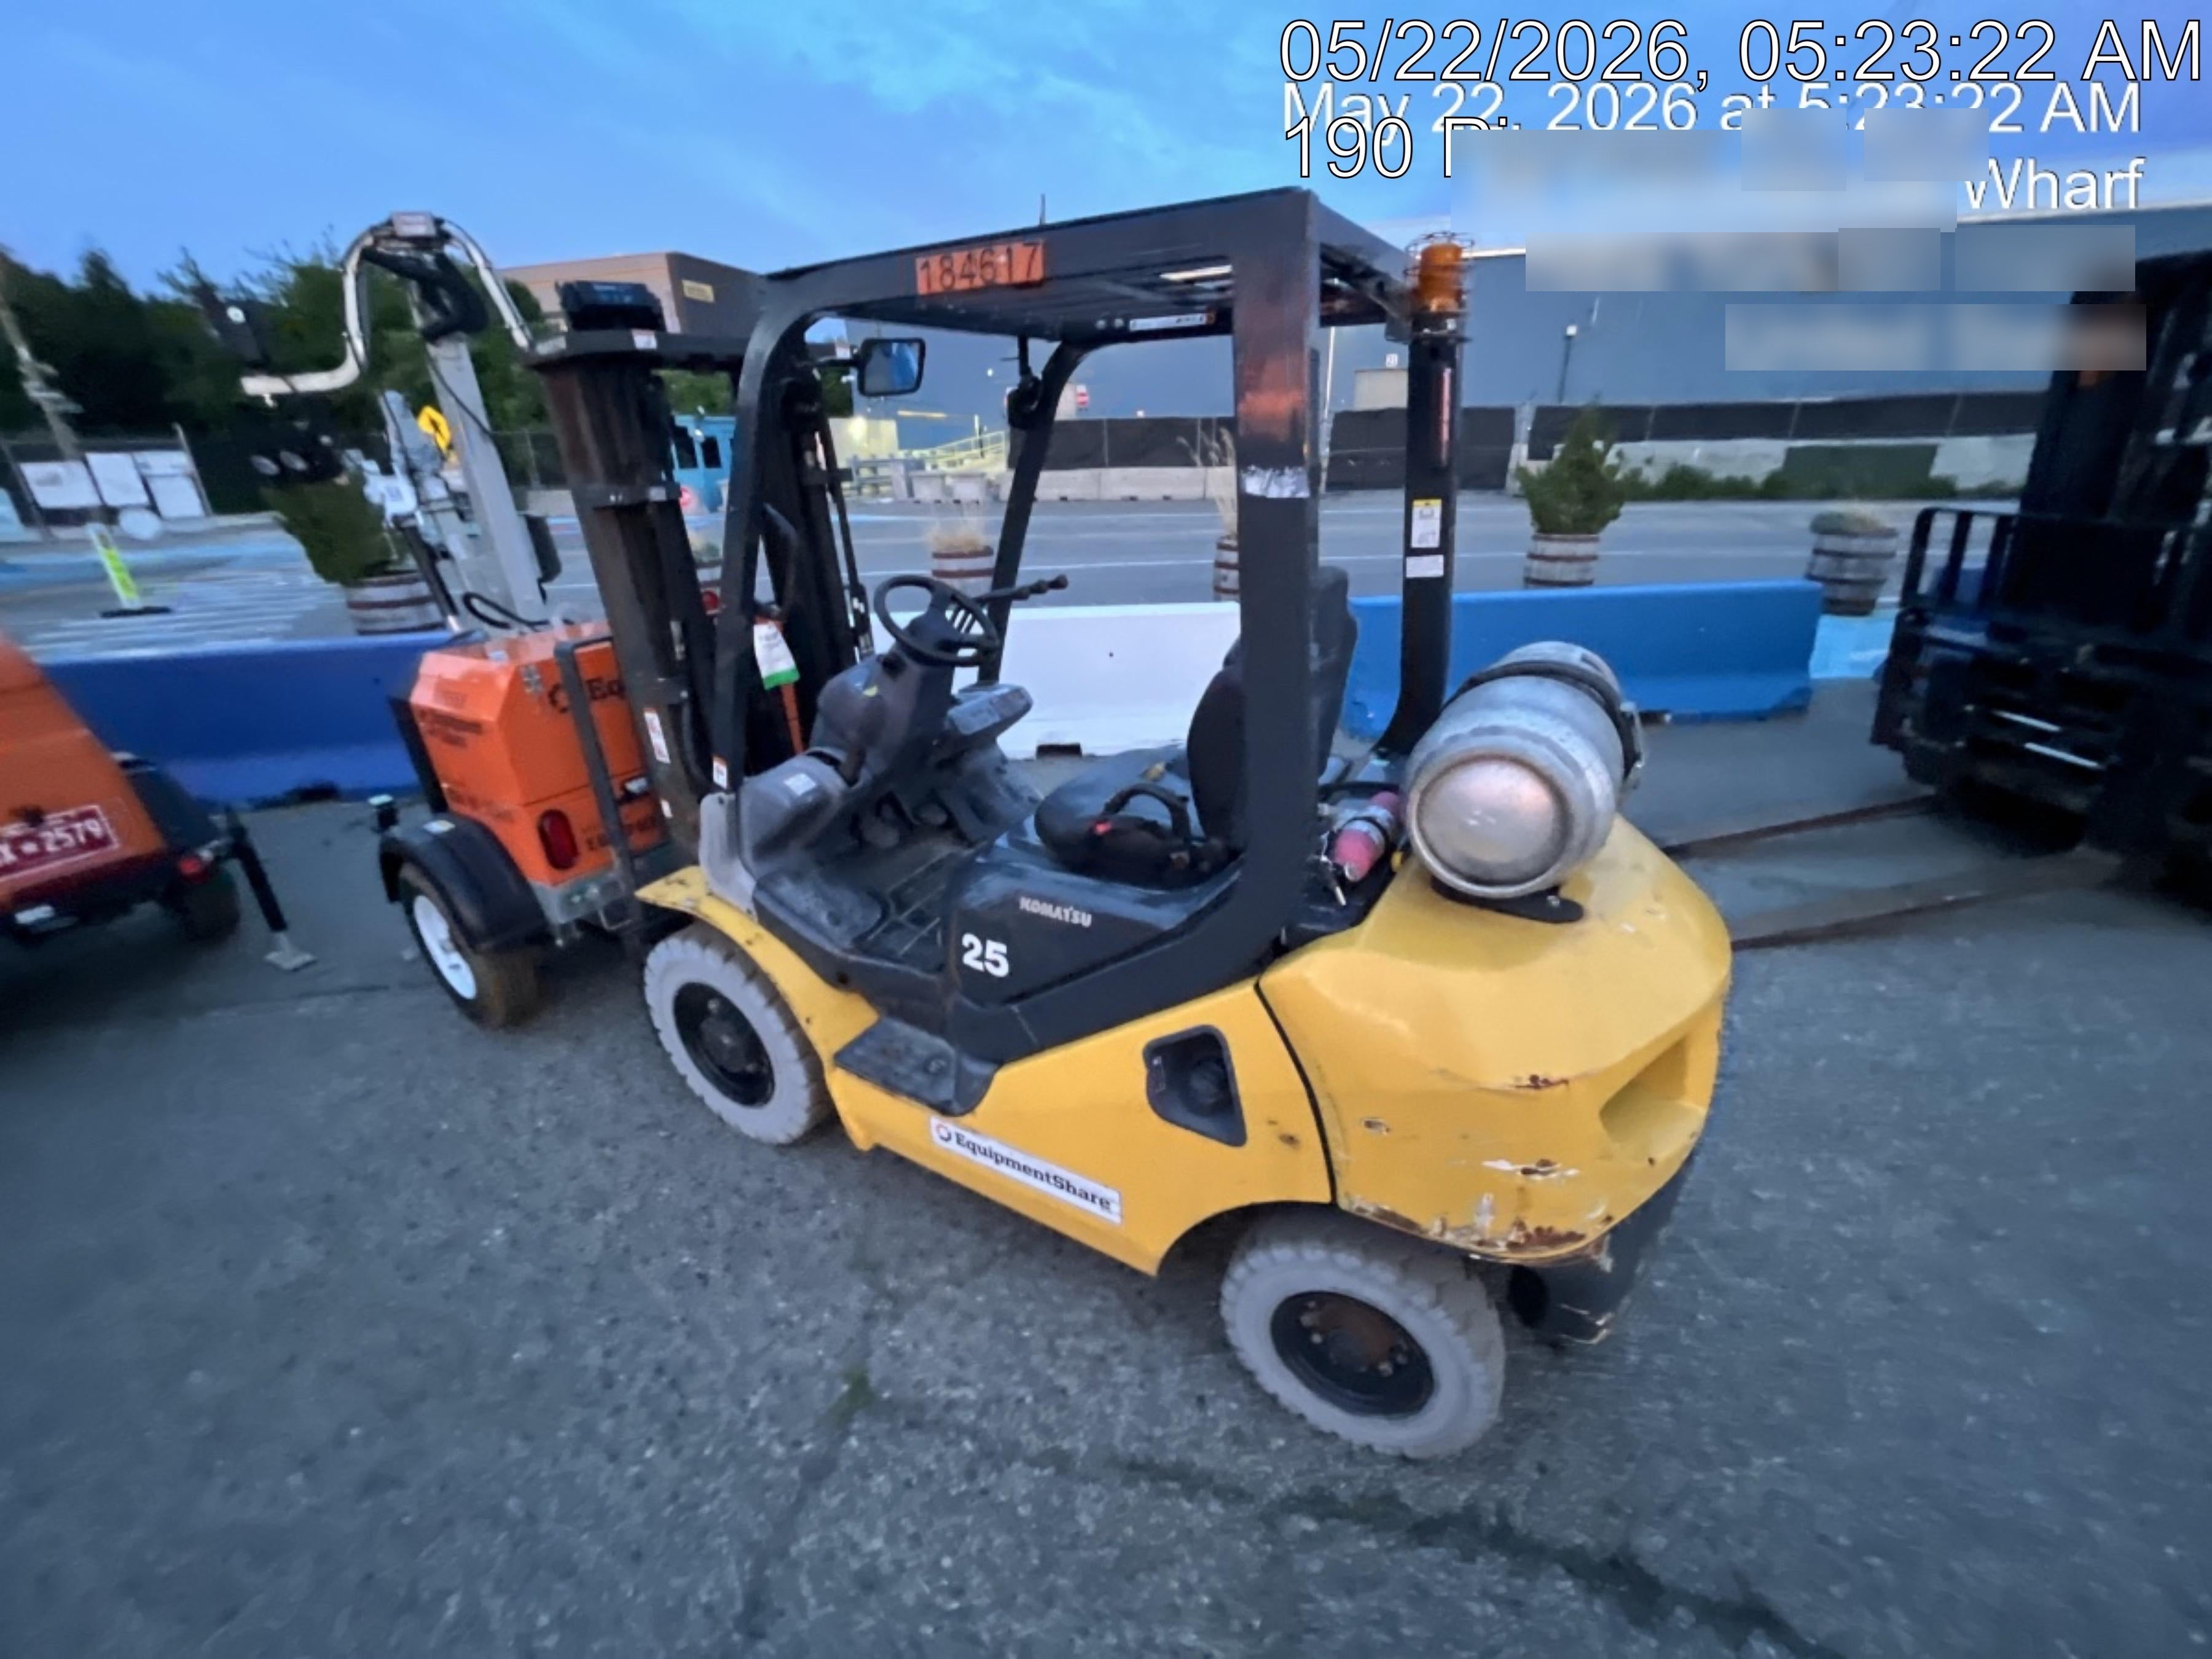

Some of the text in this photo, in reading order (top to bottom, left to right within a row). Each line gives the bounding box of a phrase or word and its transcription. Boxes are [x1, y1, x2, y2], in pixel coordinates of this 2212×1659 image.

[920, 242, 1041, 291] 184617
[1019, 896, 1092, 928] KOMATSU
[961, 932, 1010, 978] 25
[954, 1131, 1113, 1212] EquipmentShare
